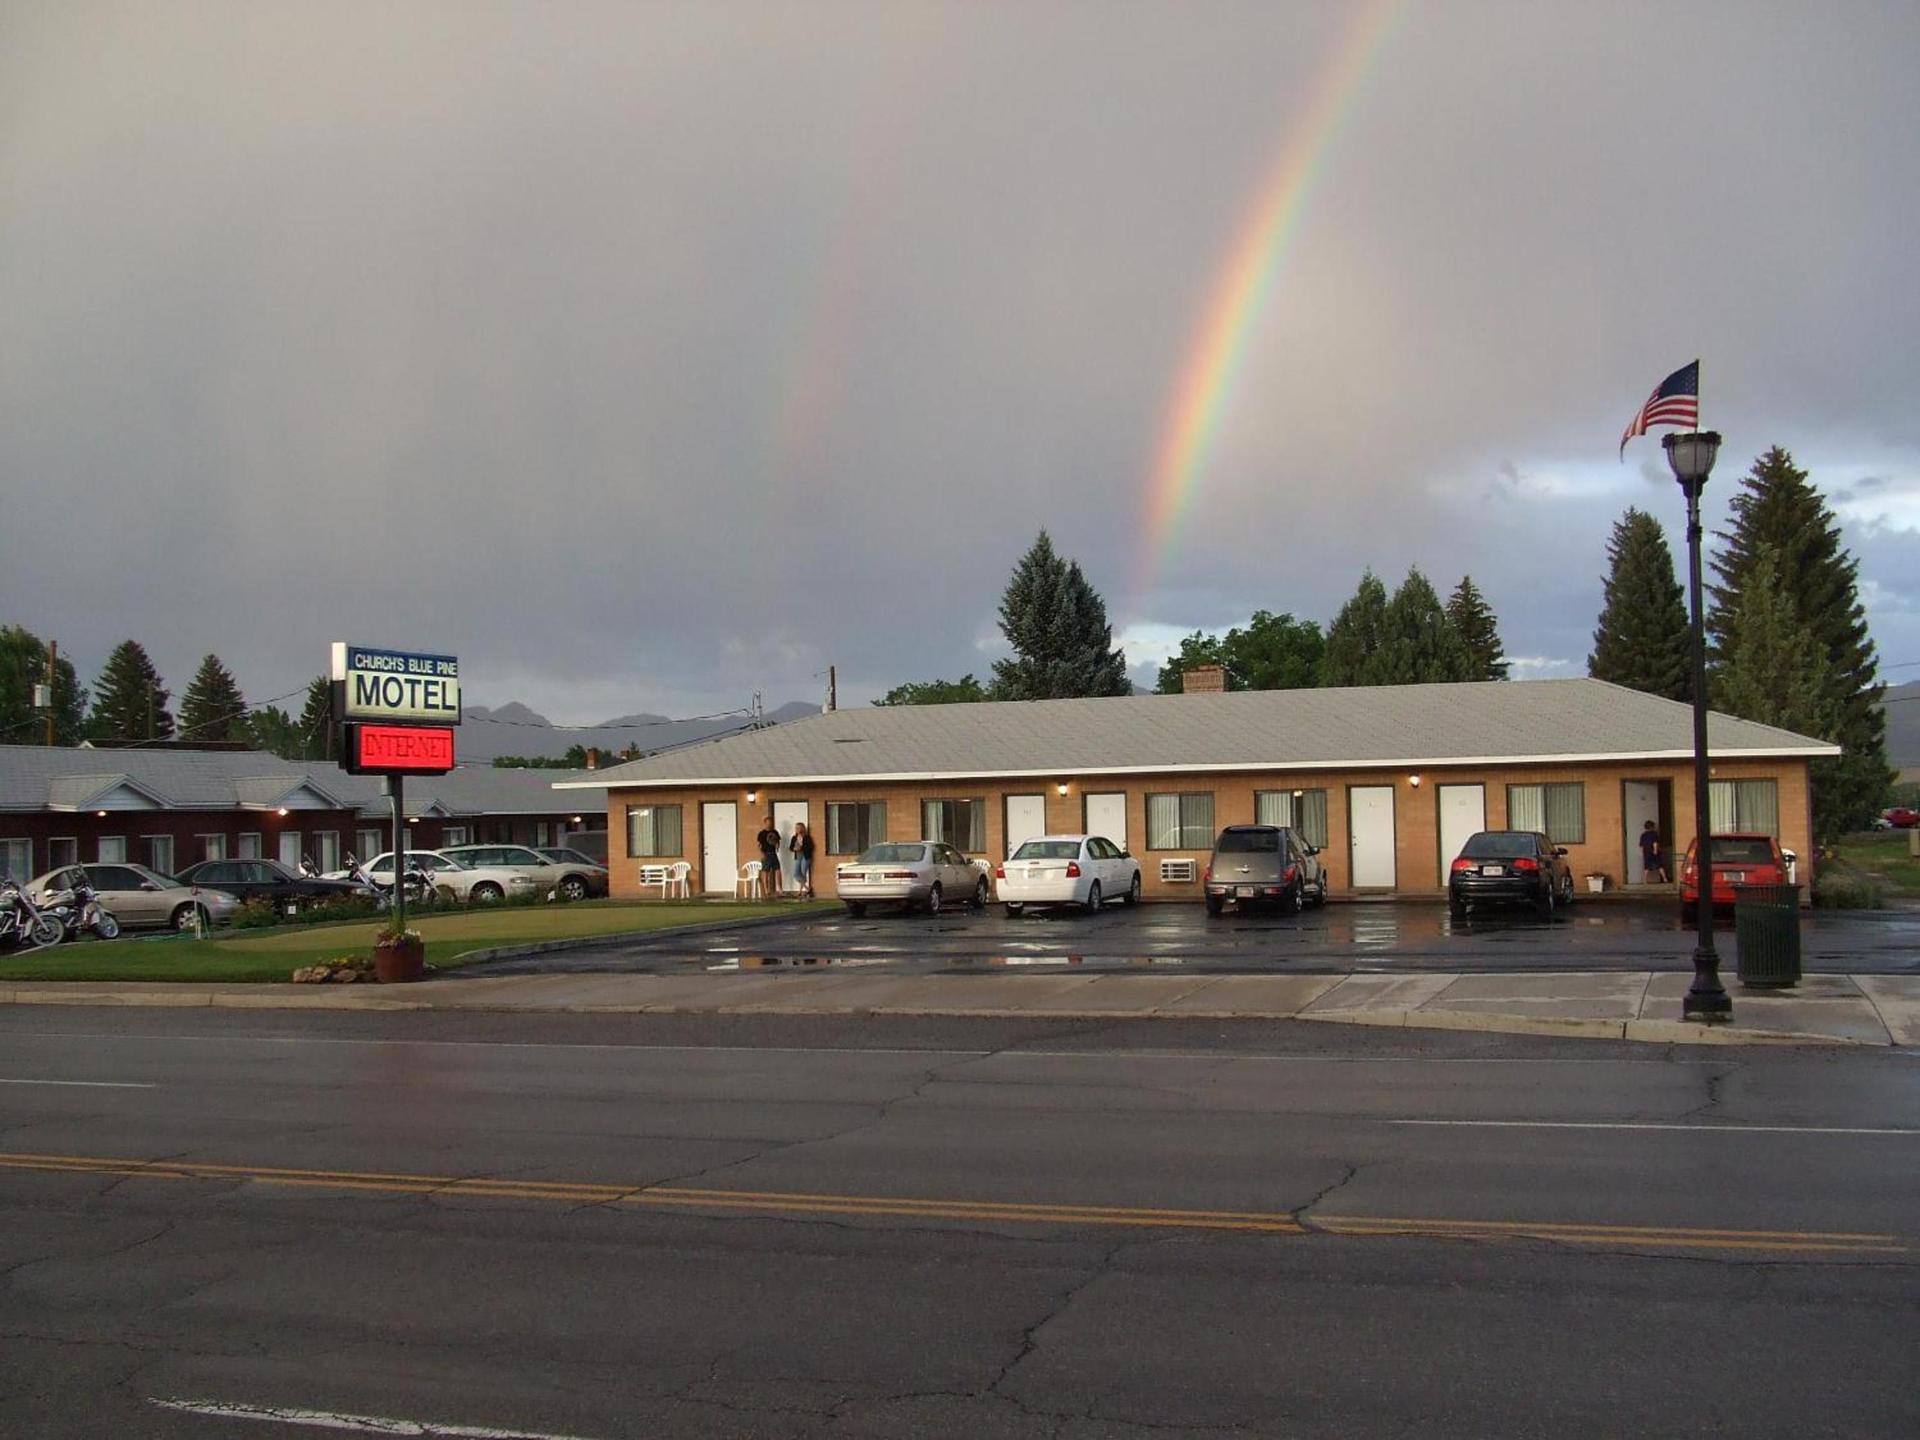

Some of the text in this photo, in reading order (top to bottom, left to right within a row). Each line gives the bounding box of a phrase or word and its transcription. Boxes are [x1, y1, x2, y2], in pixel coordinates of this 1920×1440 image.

[355, 654, 457, 675] CHURCH'S BLUE PINE
[356, 674, 456, 711] MOTEL
[365, 733, 449, 758] INTERNET
